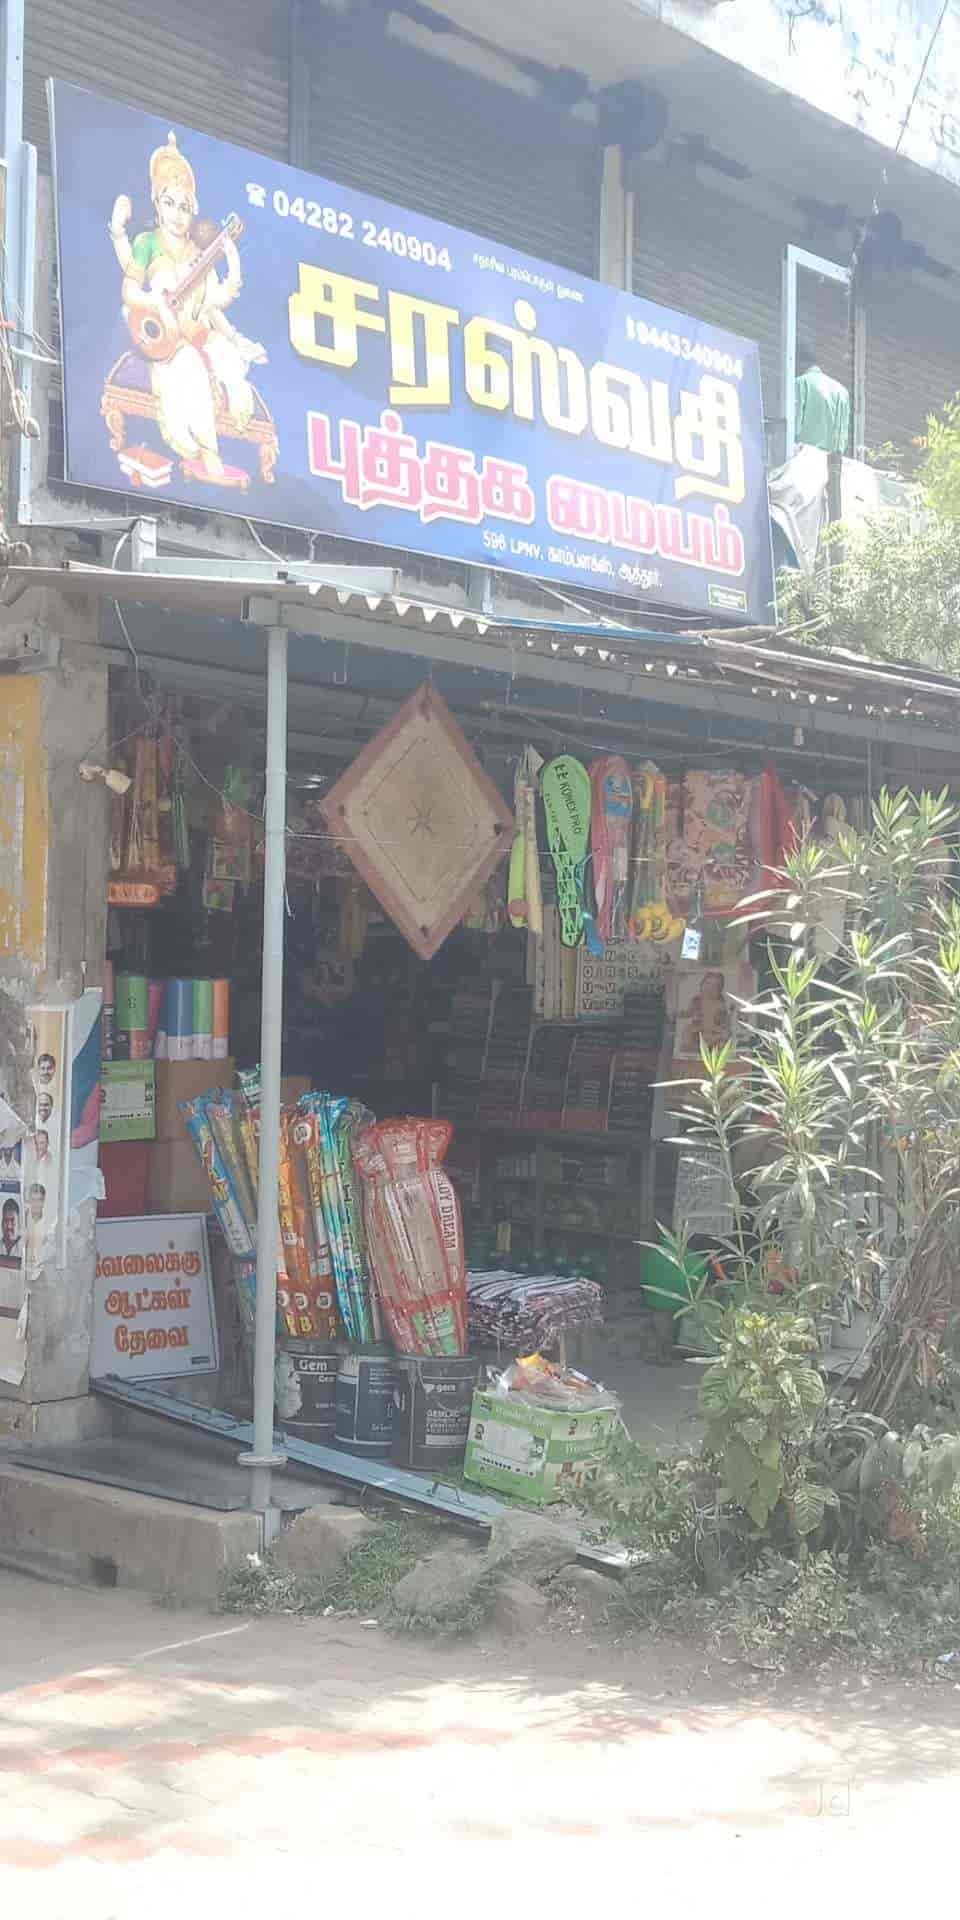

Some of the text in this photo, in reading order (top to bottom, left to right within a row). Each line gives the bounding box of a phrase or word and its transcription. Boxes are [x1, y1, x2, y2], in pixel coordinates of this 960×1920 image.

[272, 189, 452, 272] 04282 240904
[288, 262, 747, 504] சரஸ்வதி
[307, 408, 746, 577] புத்தக மையம்
[104, 1277, 192, 1319] ஆட்கள்
[113, 1324, 190, 1359] தேவை
[298, 1358, 328, 1372] Gem
